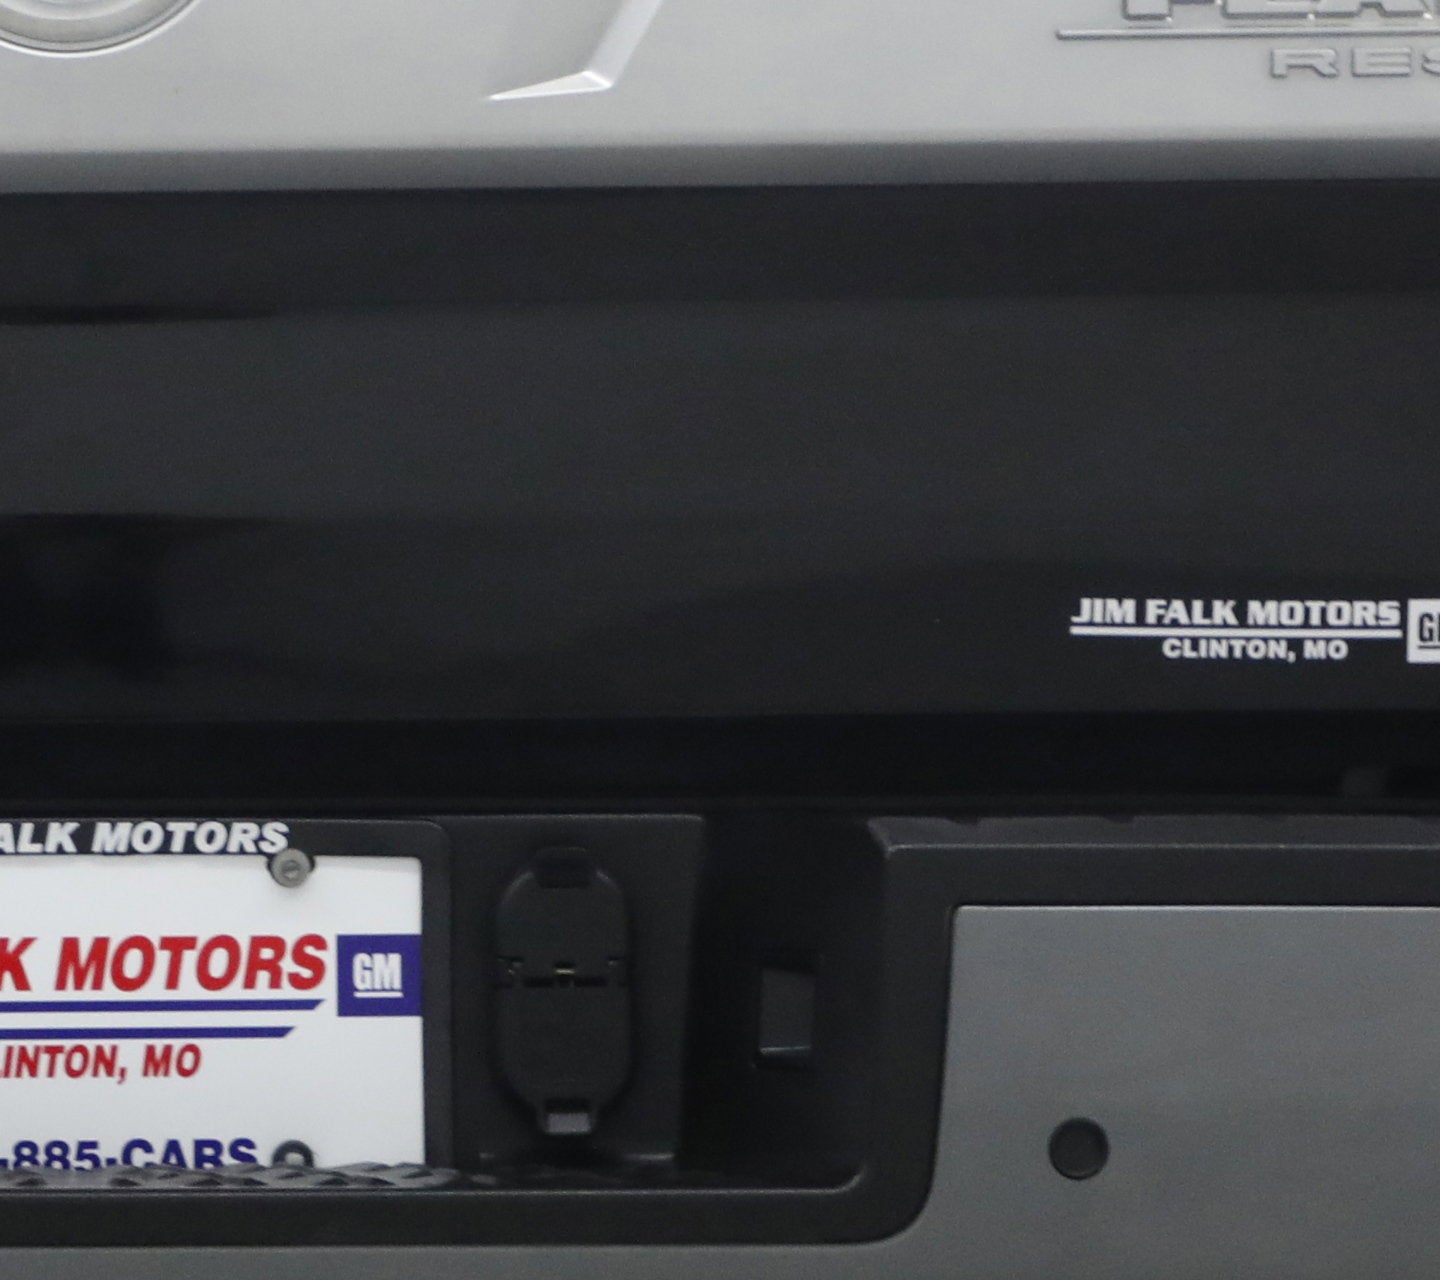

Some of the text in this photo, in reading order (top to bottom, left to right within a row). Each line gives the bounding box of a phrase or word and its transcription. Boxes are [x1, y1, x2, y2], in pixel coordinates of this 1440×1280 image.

[1070, 597, 1402, 627] JIM FALK MOTORS
[1161, 637, 1349, 663] CLINTON, MO
[90, 821, 290, 854] MOTORS
[53, 933, 329, 992] MOTORS
[351, 951, 402, 992] GM
[141, 1043, 202, 1078] MO
